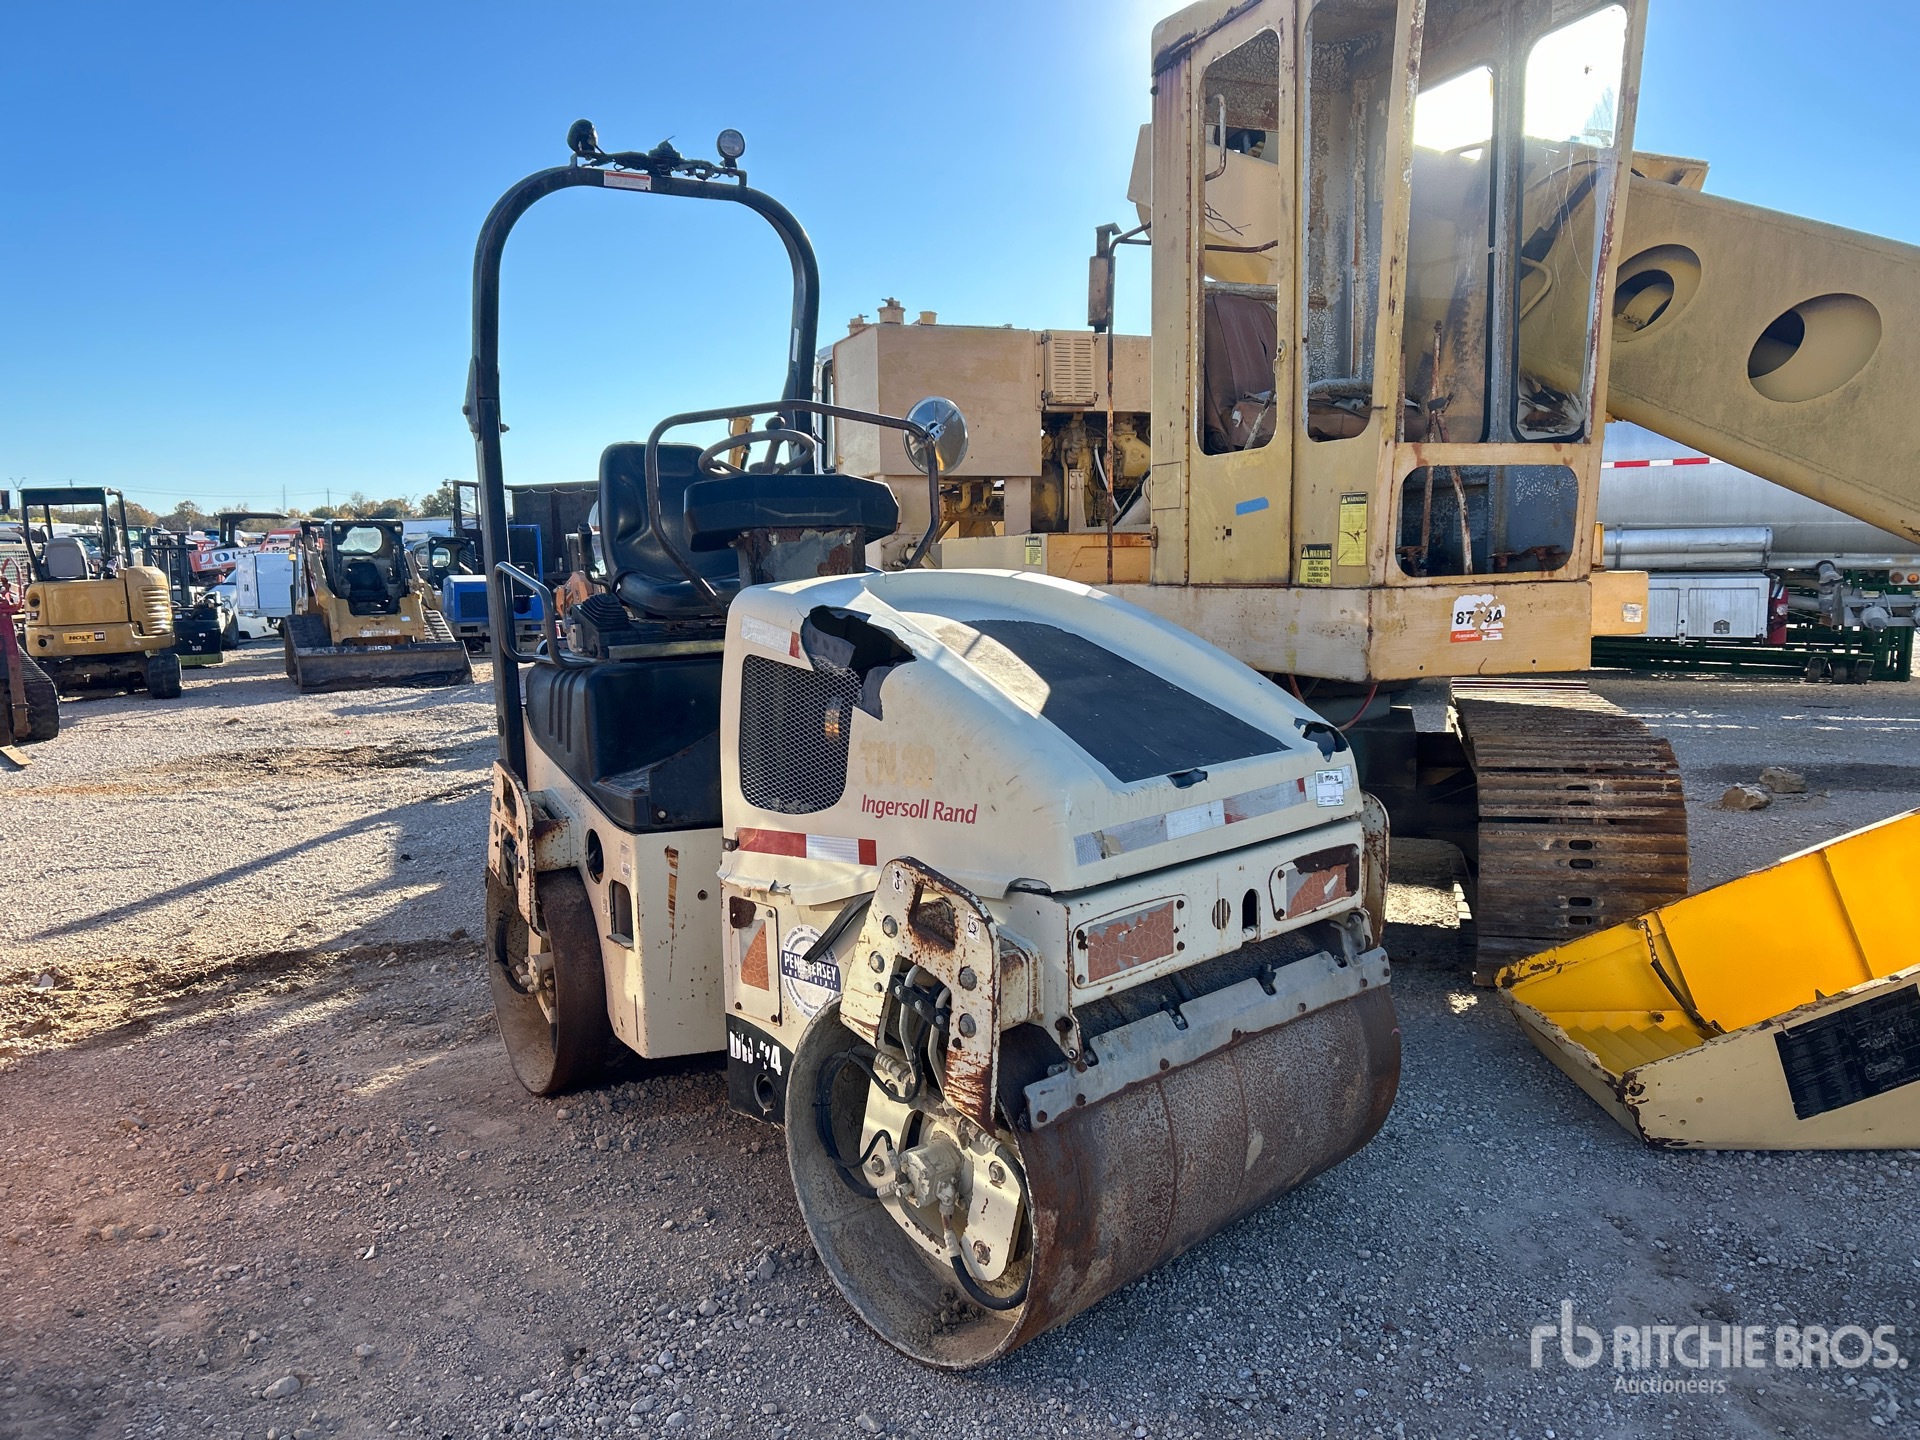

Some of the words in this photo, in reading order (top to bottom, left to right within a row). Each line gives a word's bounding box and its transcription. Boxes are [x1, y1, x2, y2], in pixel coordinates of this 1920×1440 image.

[1309, 549, 1331, 558] WARNING
[861, 794, 930, 819] Ingersoll
[932, 801, 978, 824] Rand
